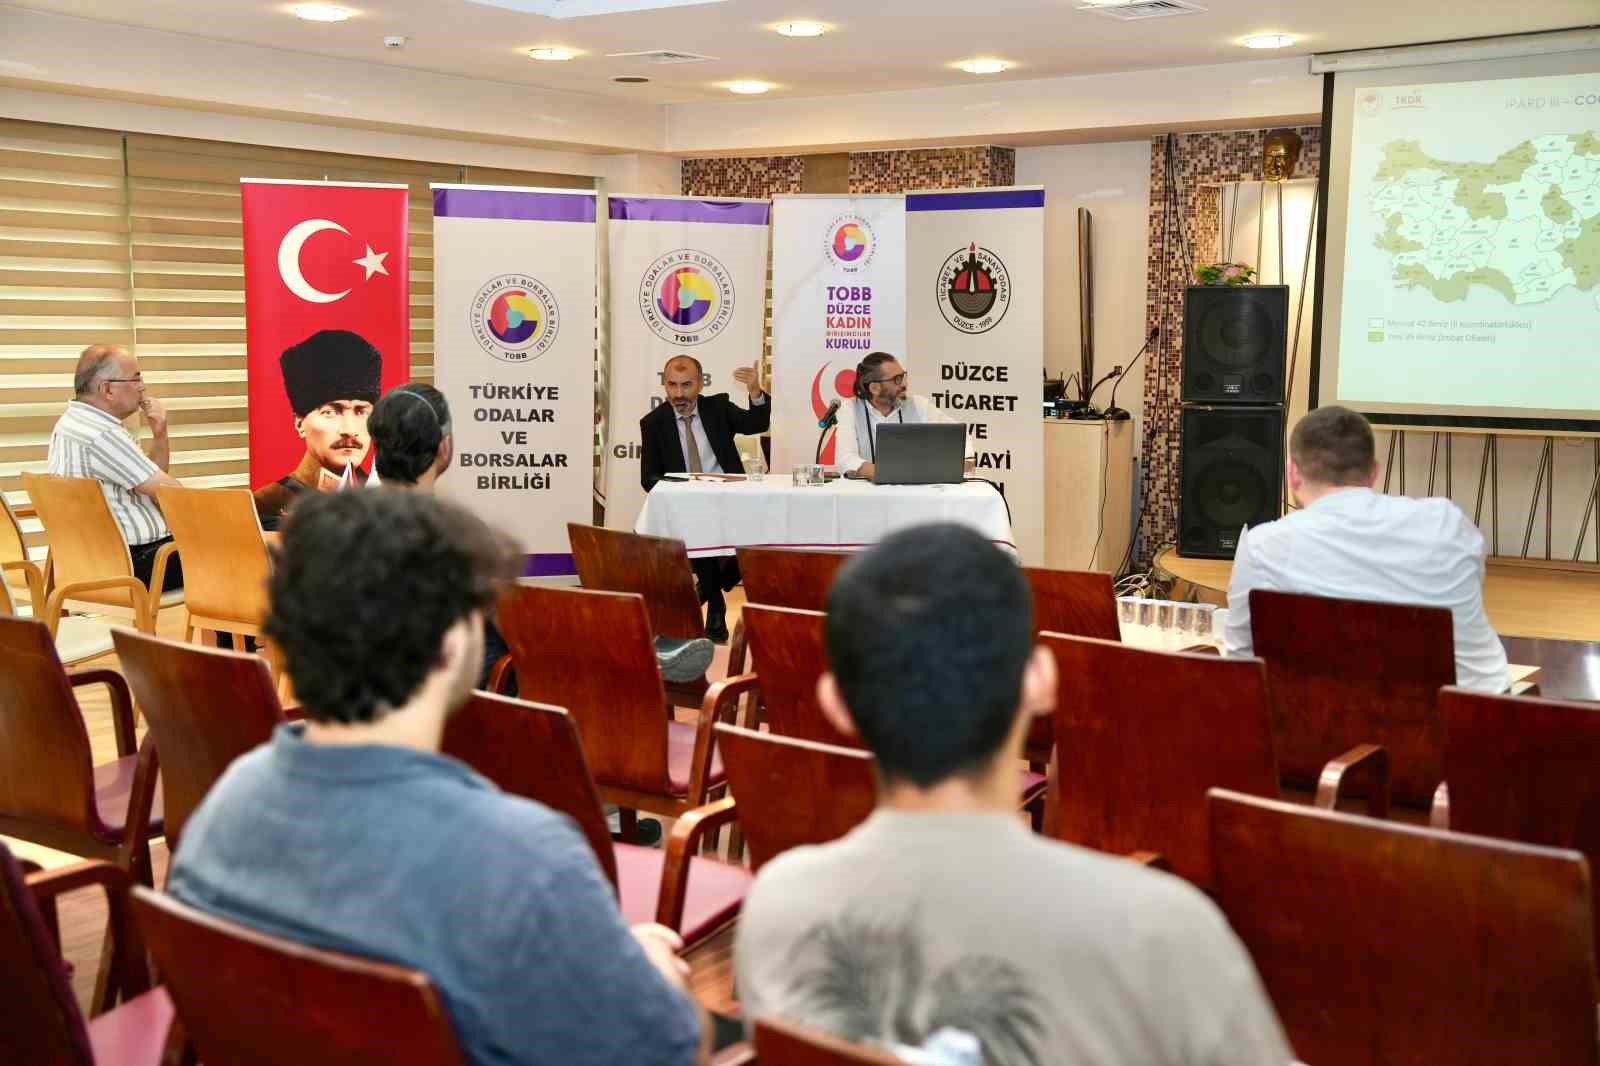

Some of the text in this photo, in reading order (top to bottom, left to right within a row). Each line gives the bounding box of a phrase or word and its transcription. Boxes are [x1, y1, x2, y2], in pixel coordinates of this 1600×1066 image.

[1574, 93, 1600, 106] CO
[954, 254, 965, 264] VE
[645, 256, 674, 287] ODALAR
[678, 253, 690, 261] VE
[694, 255, 730, 295] BORSALAR
[476, 280, 503, 309] ODALAR
[504, 277, 517, 285] VE
[826, 286, 872, 301] TOBB
[826, 302, 871, 315] DÜZCE
[826, 316, 872, 329] KADIN
[825, 338, 871, 350] KURULU
[504, 351, 528, 360] TOBB
[940, 361, 1009, 382] DÜZCE
[657, 372, 713, 387] TB
[469, 382, 559, 401] TÜRKİYE
[931, 392, 1019, 412] TİCARET
[473, 408, 555, 423] ODALAR
[500, 431, 528, 445] VE
[460, 453, 568, 468] BORSALAR
[476, 473, 551, 490] BİRLİĞİ
